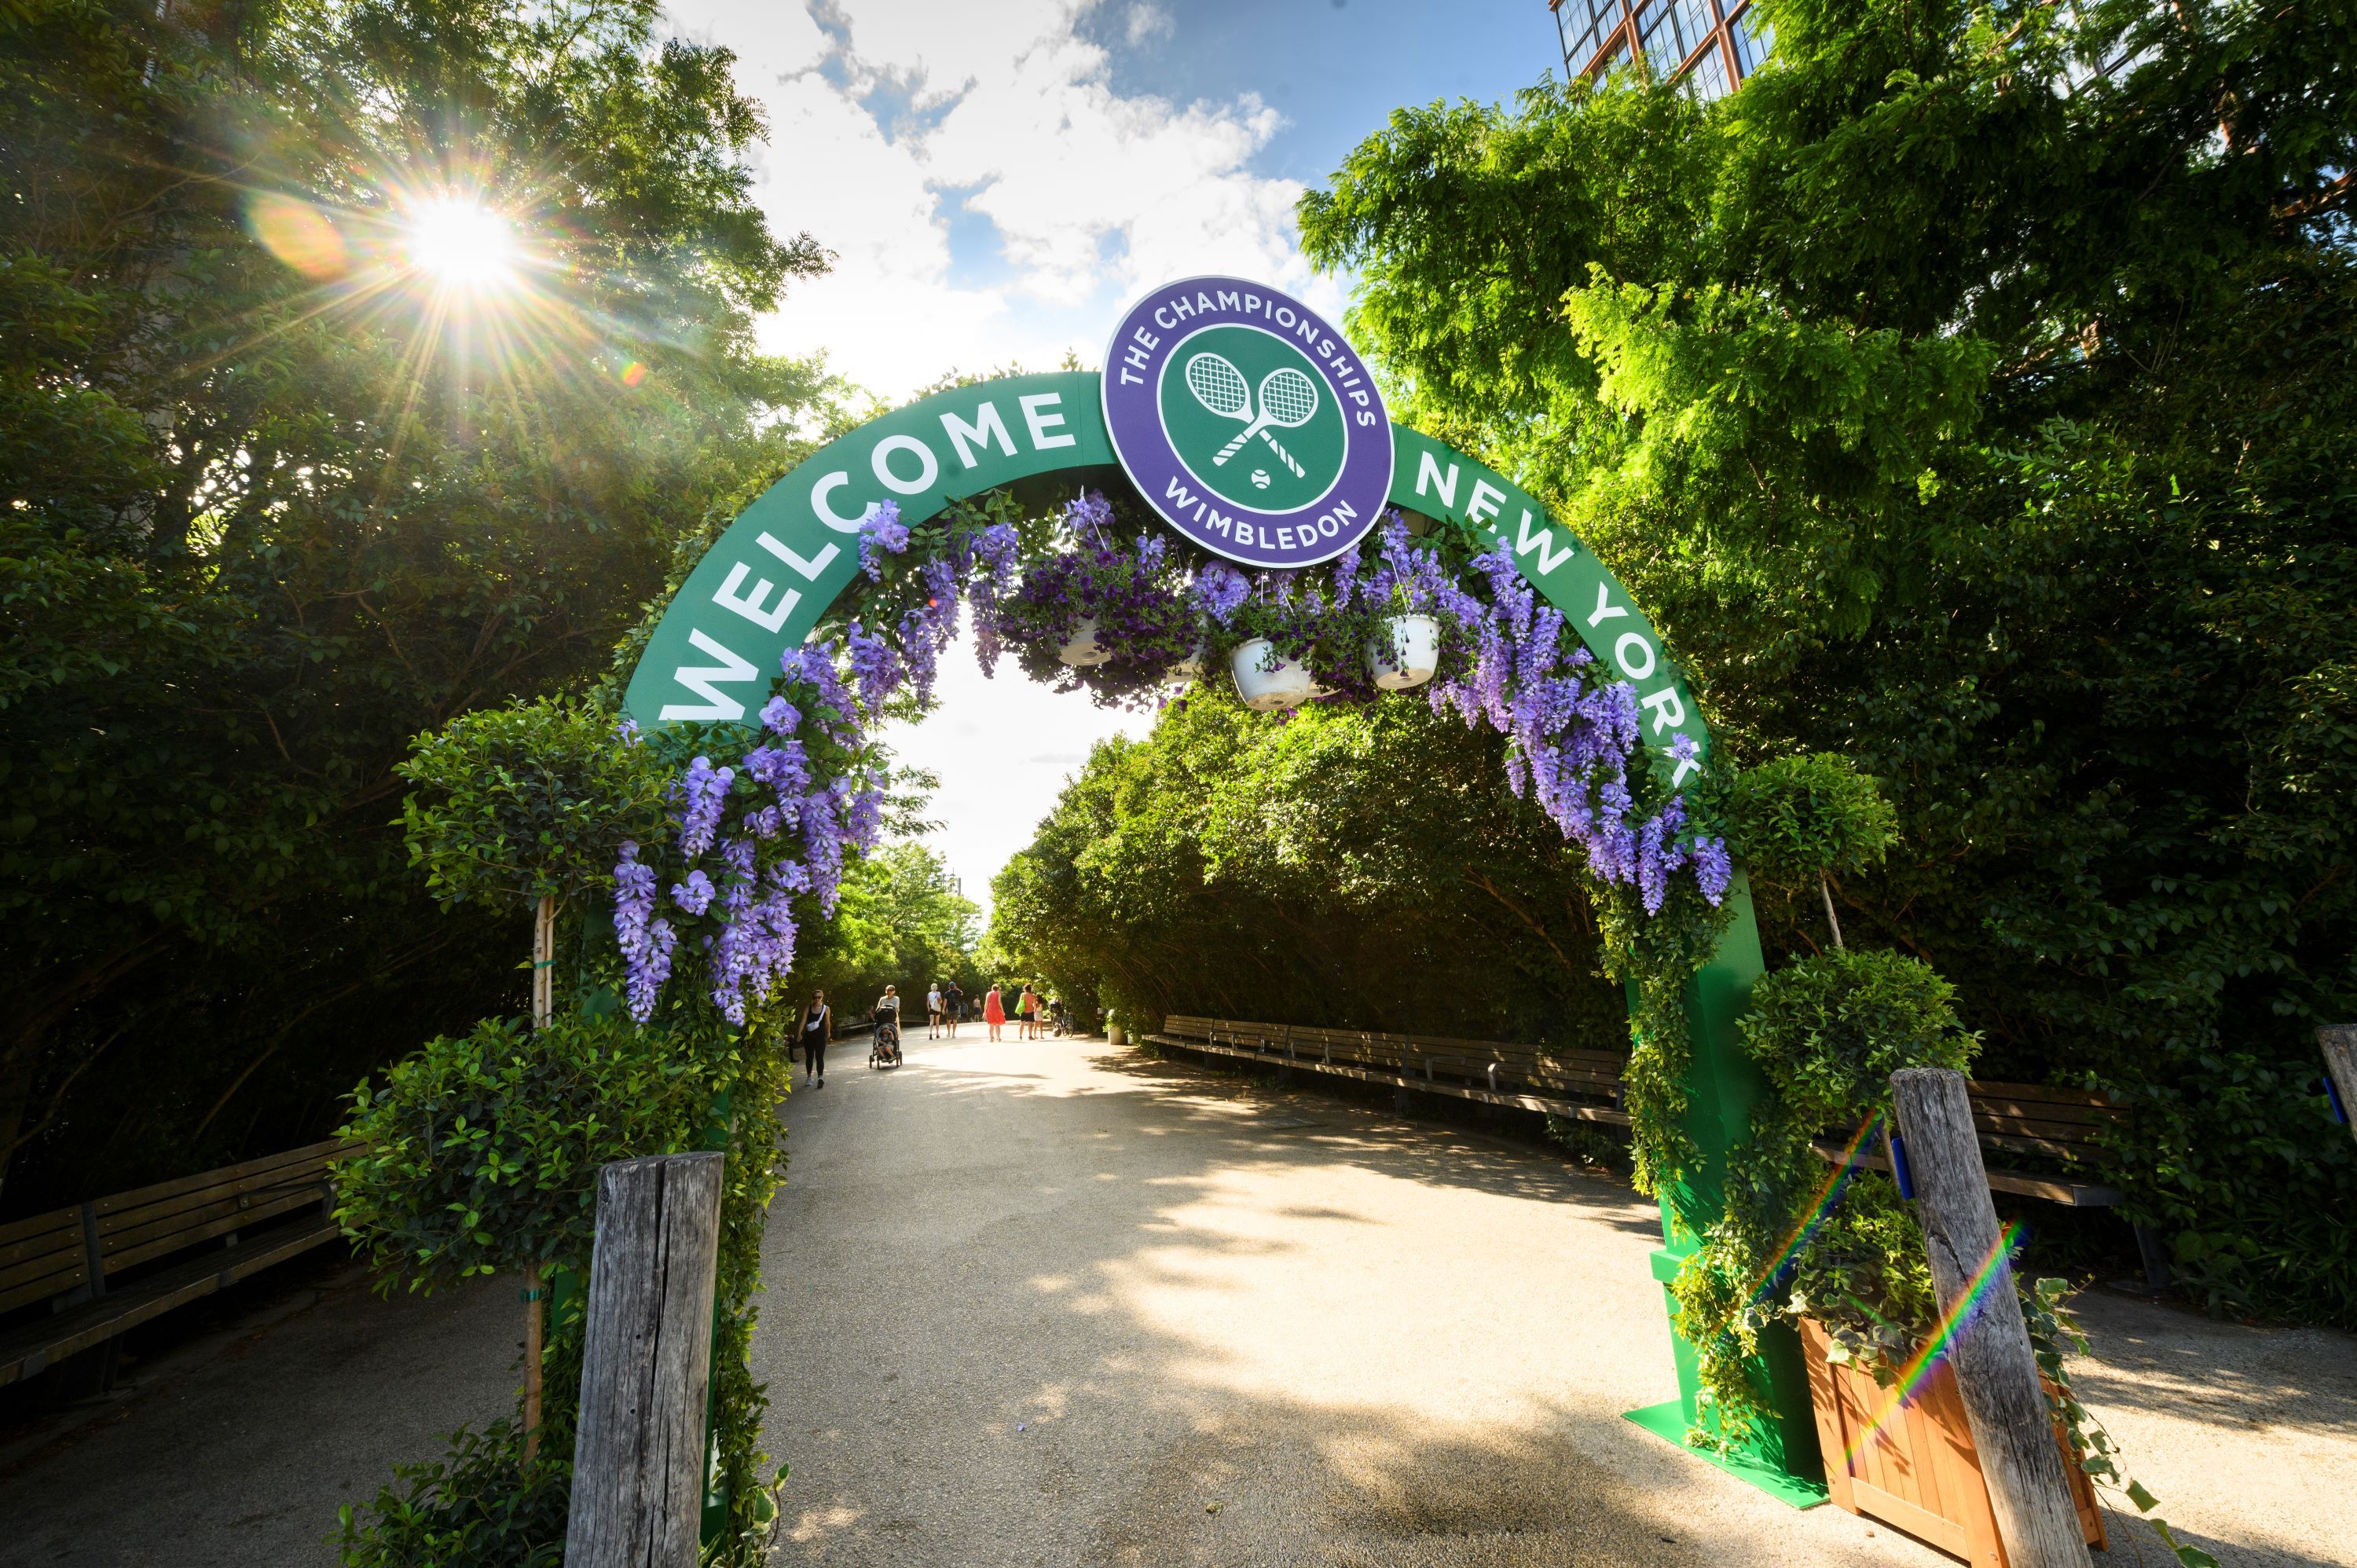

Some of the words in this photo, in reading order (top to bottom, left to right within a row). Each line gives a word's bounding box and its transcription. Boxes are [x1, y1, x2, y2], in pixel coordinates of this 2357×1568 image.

[1120, 326, 1160, 386] THE
[1154, 291, 1376, 427] CHAMPIONSHIPS
[658, 392, 1076, 721] WELCOME
[1165, 476, 1358, 550] WIMBLEDON
[1416, 451, 1574, 576] NEW
